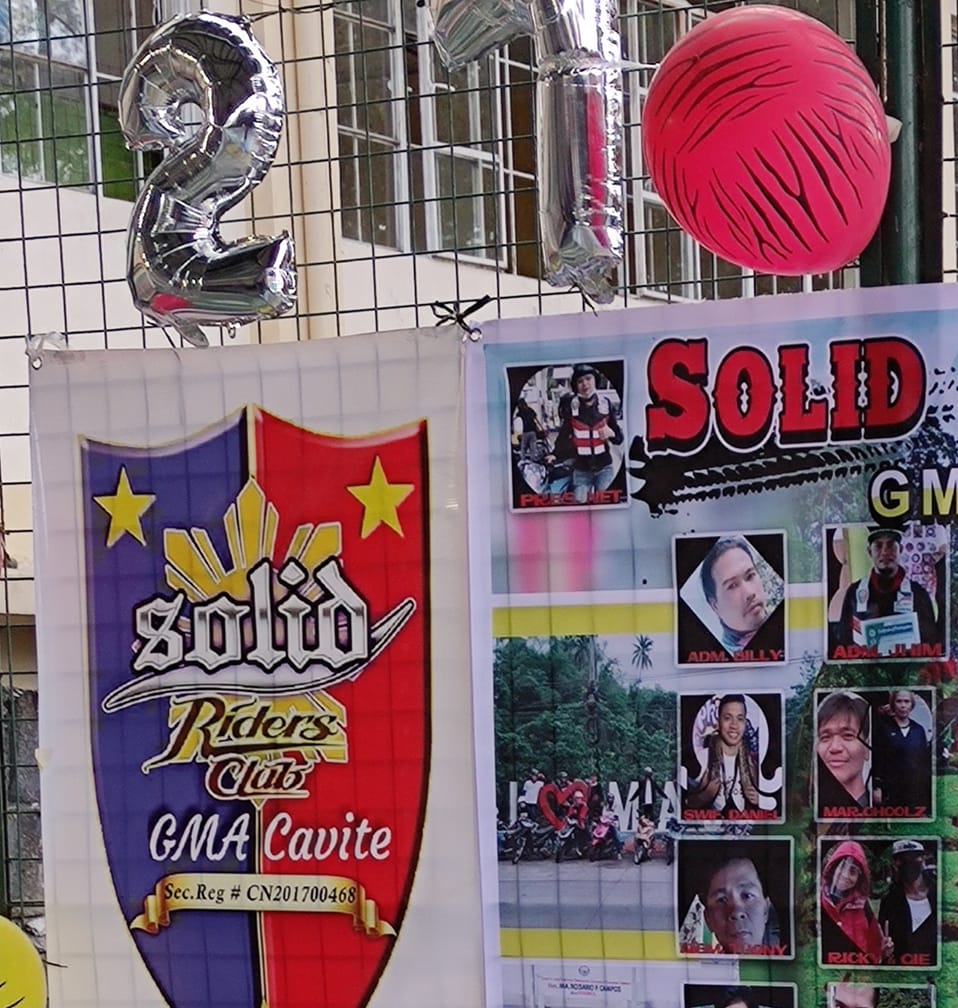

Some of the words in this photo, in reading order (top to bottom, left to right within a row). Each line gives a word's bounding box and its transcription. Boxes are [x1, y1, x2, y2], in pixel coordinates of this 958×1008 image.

[646, 337, 927, 455] SOLID
[142, 693, 344, 773] Riders
[205, 752, 314, 800] Club
[150, 813, 250, 861] GMA
[264, 811, 392, 860] Cavite
[246, 884, 357, 905] CN201700468
